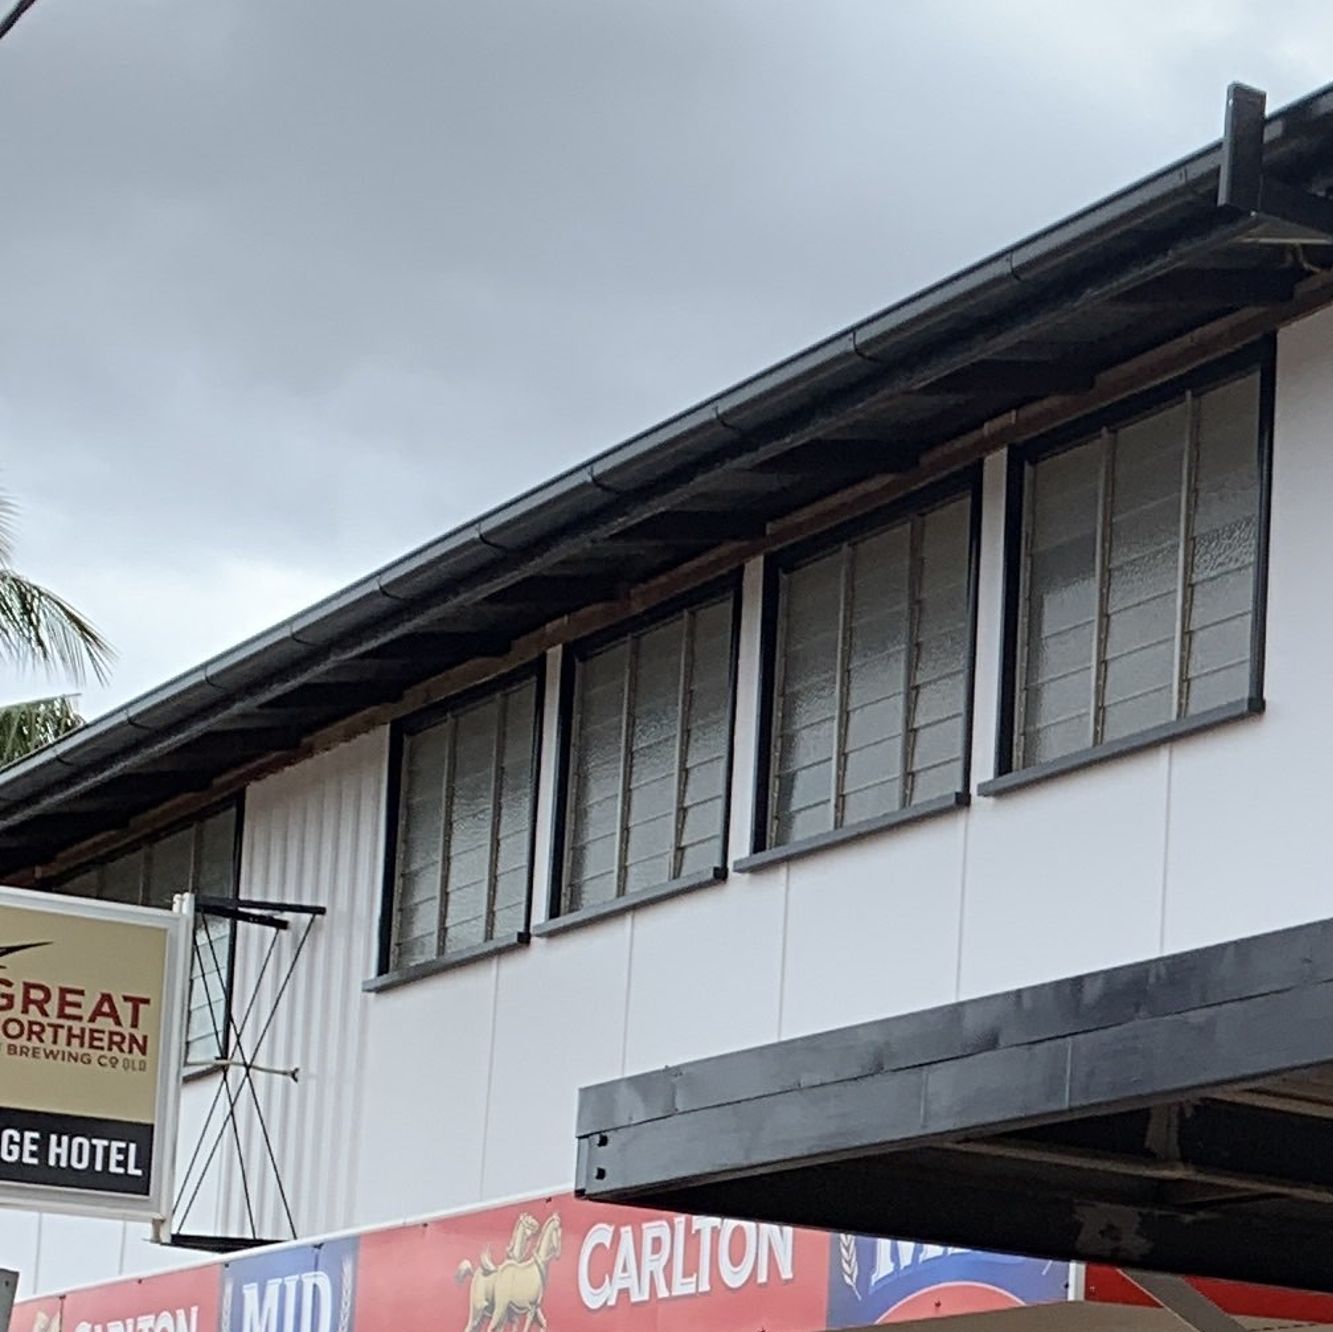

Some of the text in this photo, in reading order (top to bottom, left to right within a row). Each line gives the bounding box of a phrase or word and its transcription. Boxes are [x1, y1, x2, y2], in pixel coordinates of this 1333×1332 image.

[0, 1017, 148, 1056] ORTHERN
[7, 1043, 92, 1065] BREWING
[1, 1128, 143, 1176] GE HOTEL
[578, 1215, 794, 1310] CARLTON
